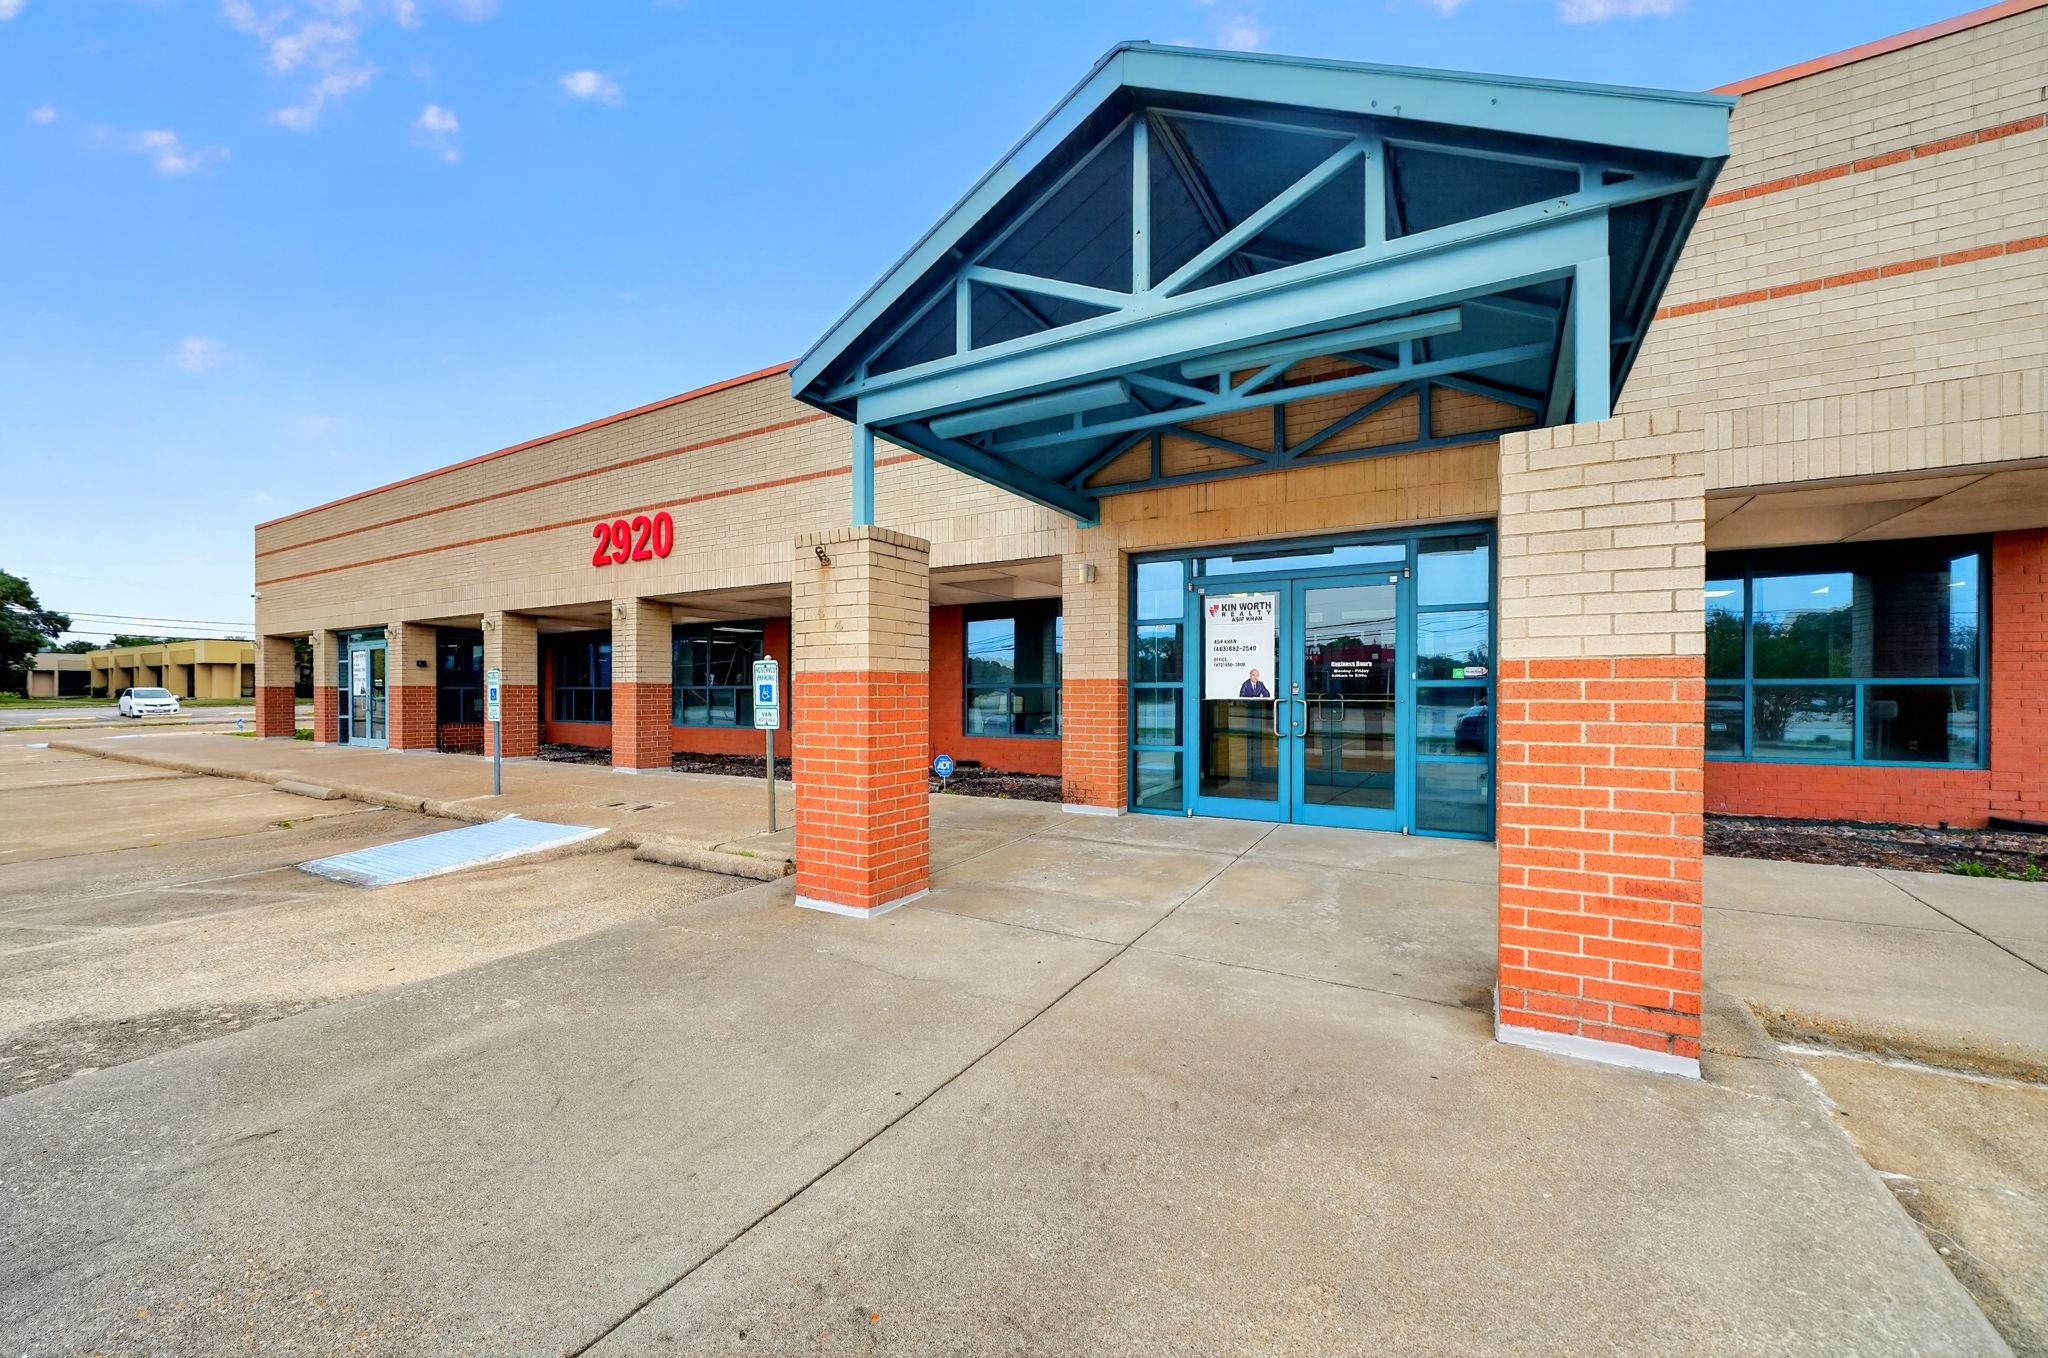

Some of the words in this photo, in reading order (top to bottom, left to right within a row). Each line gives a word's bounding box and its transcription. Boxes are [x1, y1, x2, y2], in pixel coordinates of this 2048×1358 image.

[592, 511, 674, 567] 2920
[1221, 603, 1237, 611] KIN
[1239, 601, 1272, 611] WORTH
[936, 761, 952, 770] ADT
